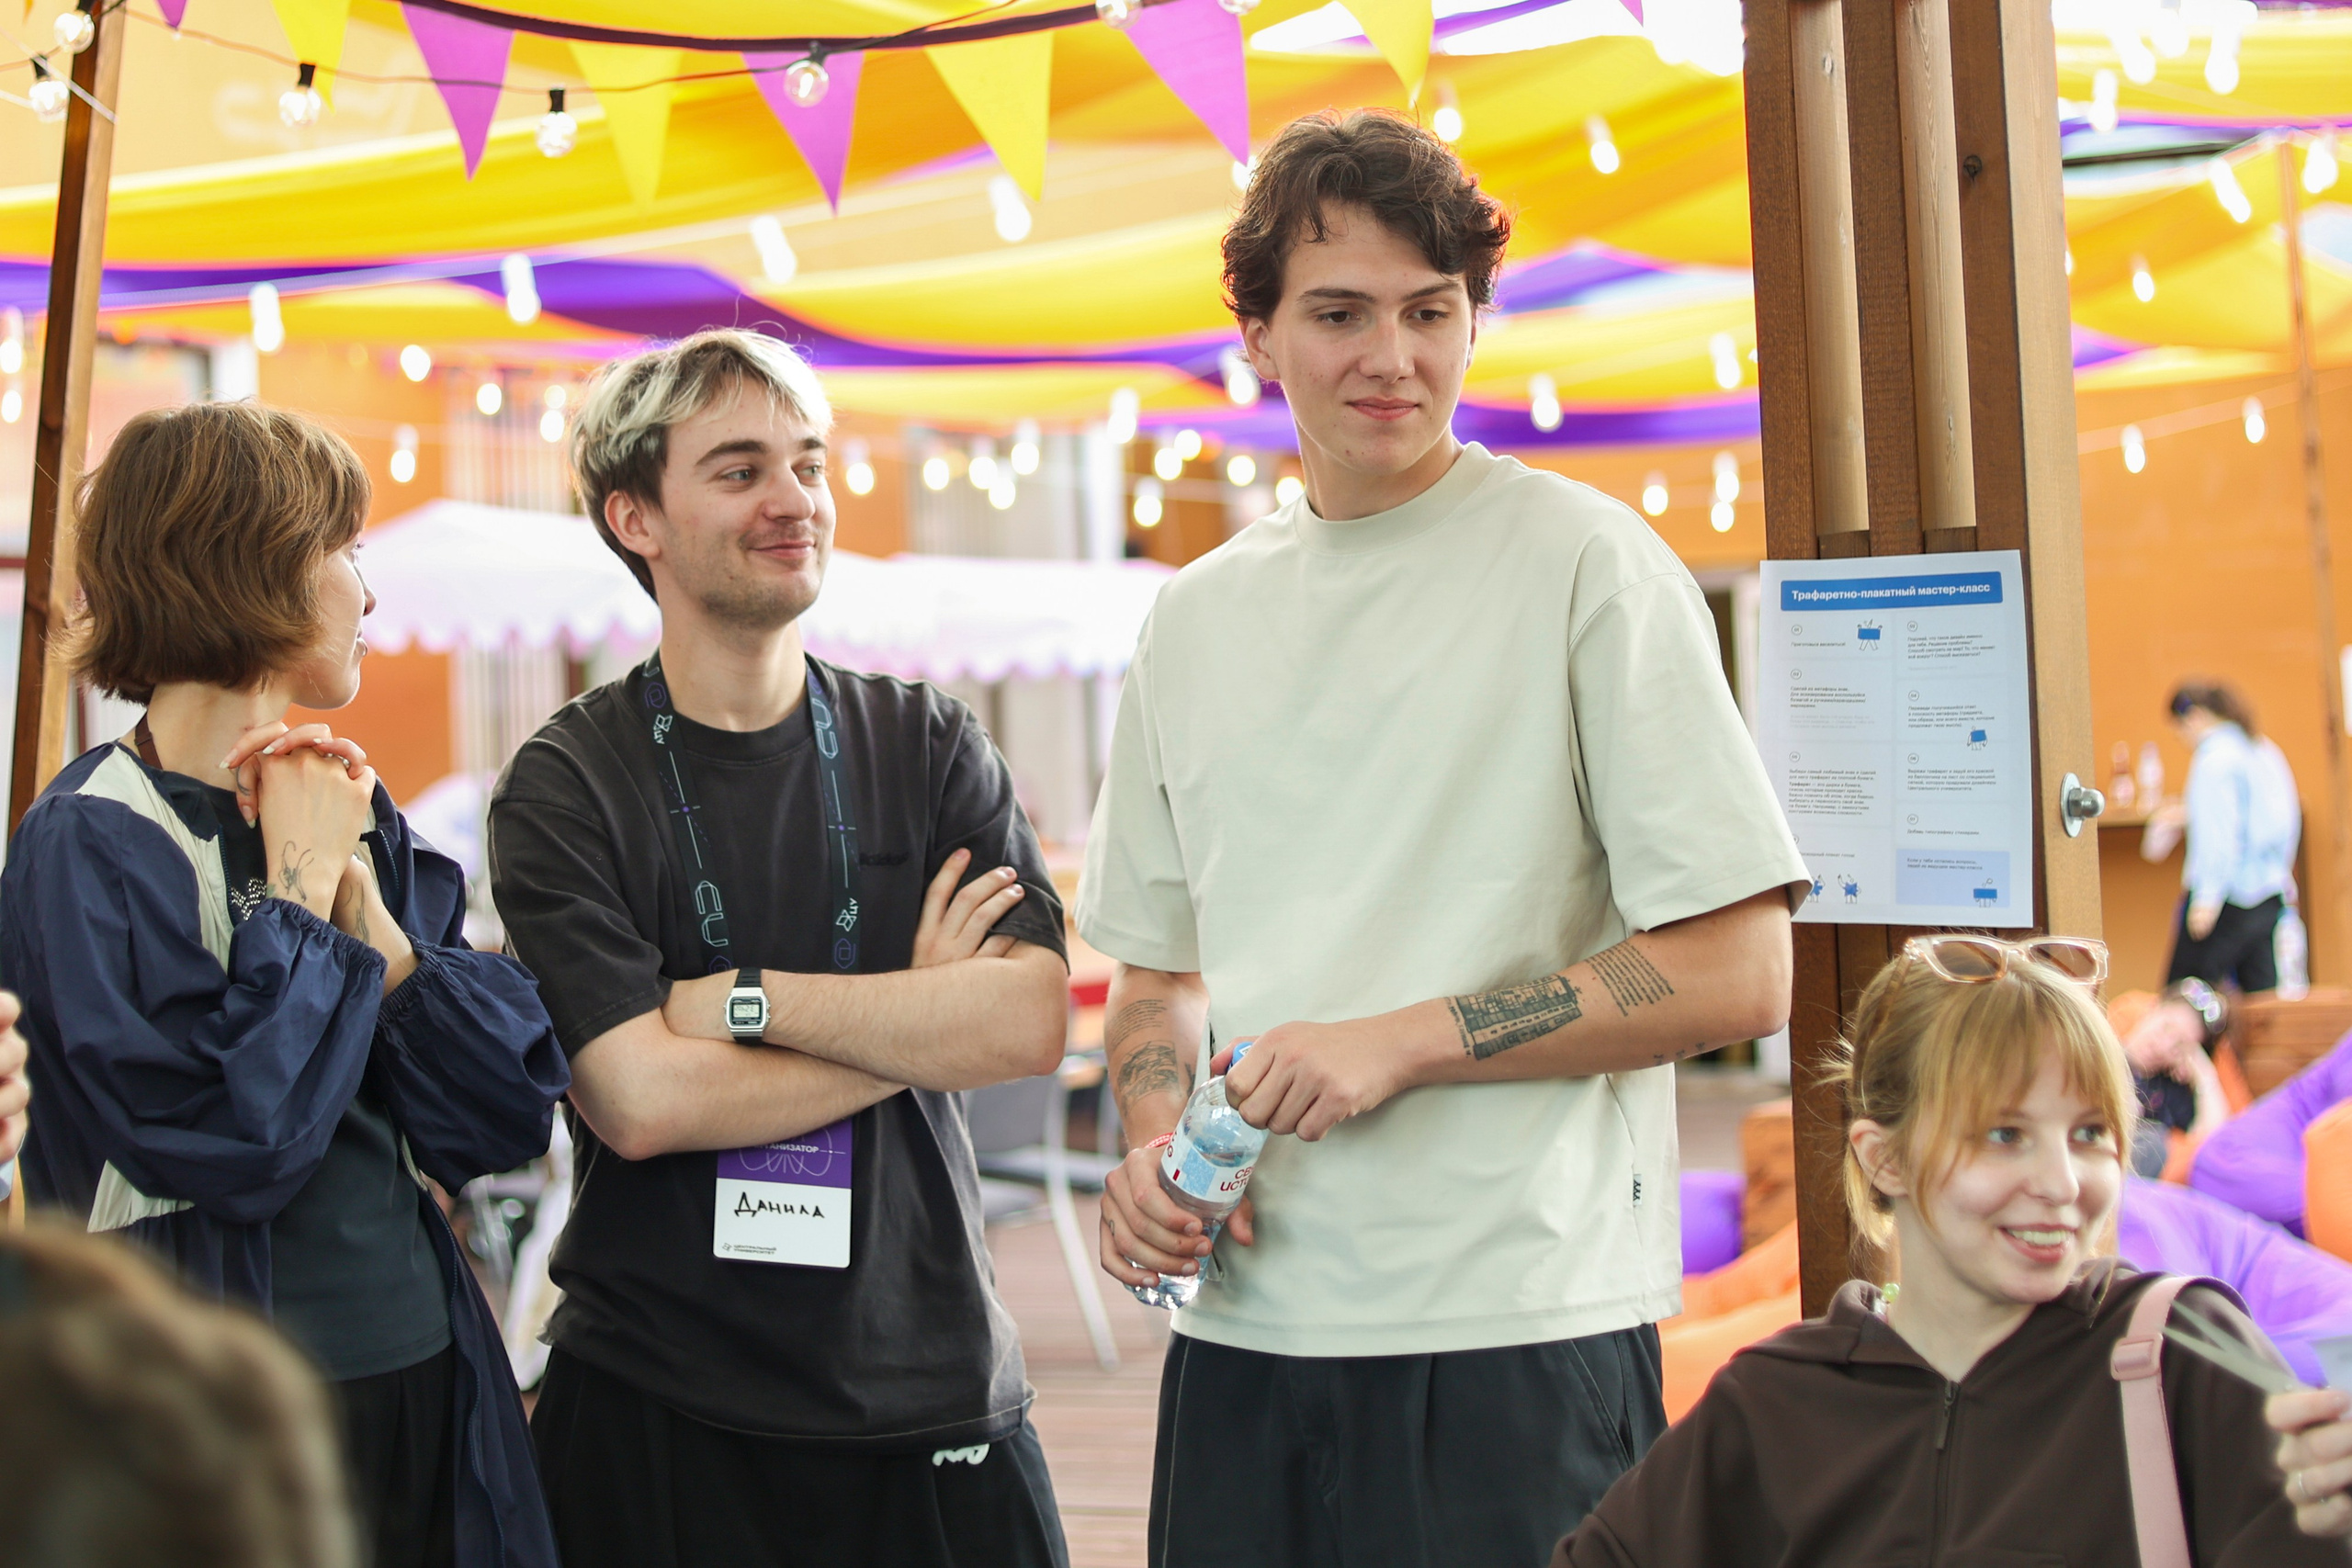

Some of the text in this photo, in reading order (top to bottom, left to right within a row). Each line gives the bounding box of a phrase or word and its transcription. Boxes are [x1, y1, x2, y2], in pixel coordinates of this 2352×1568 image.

[1792, 584, 1990, 601] Трафаретно-плакатный мастер-класс
[755, 1143, 820, 1154] АНИЗАТОР
